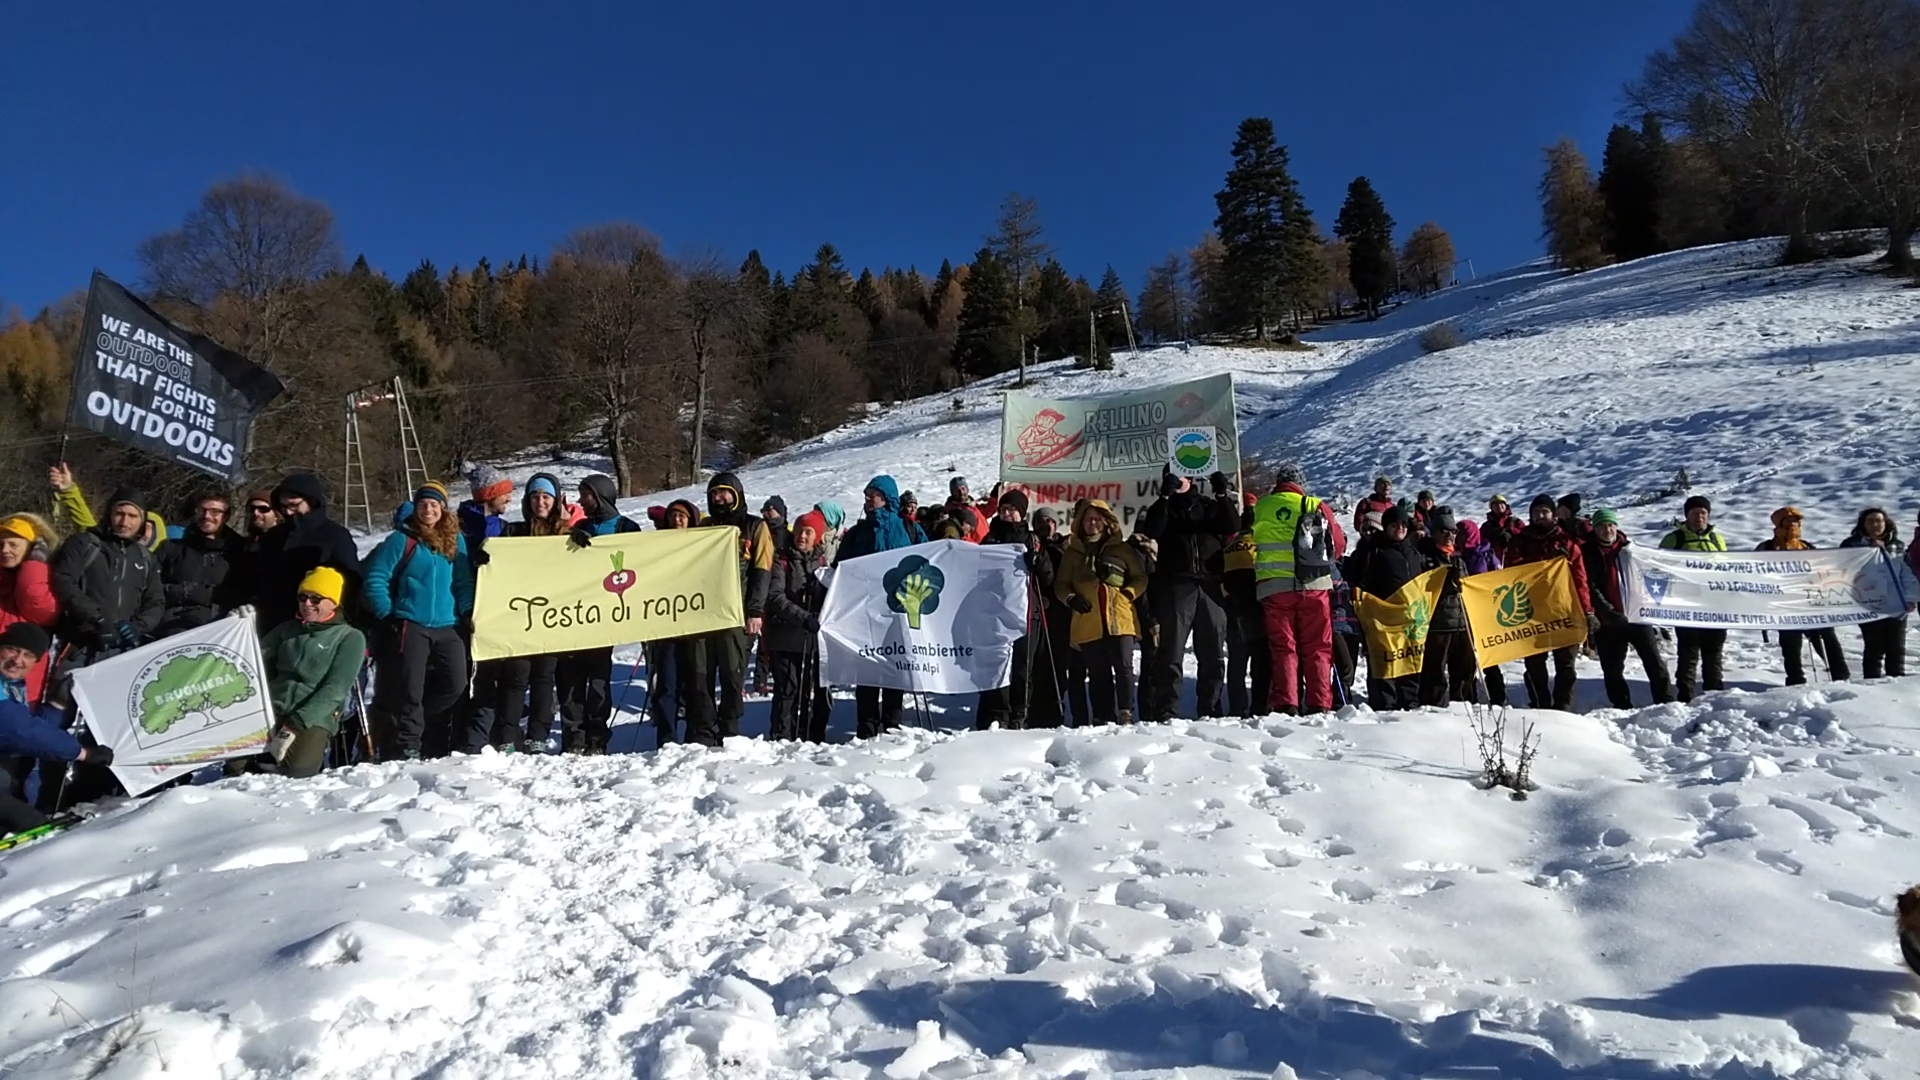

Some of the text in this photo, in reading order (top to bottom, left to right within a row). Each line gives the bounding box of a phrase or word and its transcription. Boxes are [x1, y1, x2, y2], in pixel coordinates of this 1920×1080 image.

[101, 313, 194, 367] WE ARE THE
[97, 331, 192, 385] OUTDOOR
[96, 350, 217, 415] THAT FIGHTS
[87, 390, 235, 466] OUTDOORS
[151, 395, 215, 432] FOR THE
[1172, 428, 1213, 443] ASSOCIAZIONE
[1170, 455, 1188, 474] MONTE
[1037, 483, 1122, 504] IMPIANTI
[1685, 558, 1812, 574] CLUB ALPINO ITALIANO
[1706, 580, 1784, 595] CAI LOMBARDIA
[509, 592, 705, 632] Testa di rapa
[1640, 607, 1879, 625] COMMISSIONE REGIONALE TUTELA AMBIENTE MONTANO
[1481, 617, 1575, 649] LEGAMBIENTE
[858, 641, 973, 658] circolo ambiente
[131, 684, 141, 718] COMITATO
[140, 667, 152, 680] PER
[166, 647, 192, 659] PARCO
[197, 646, 237, 661] REGIONALE
[239, 661, 255, 681] DELLA
[895, 660, 940, 676] Ilaria Alpi
[154, 673, 234, 706] BRUGHIERA
